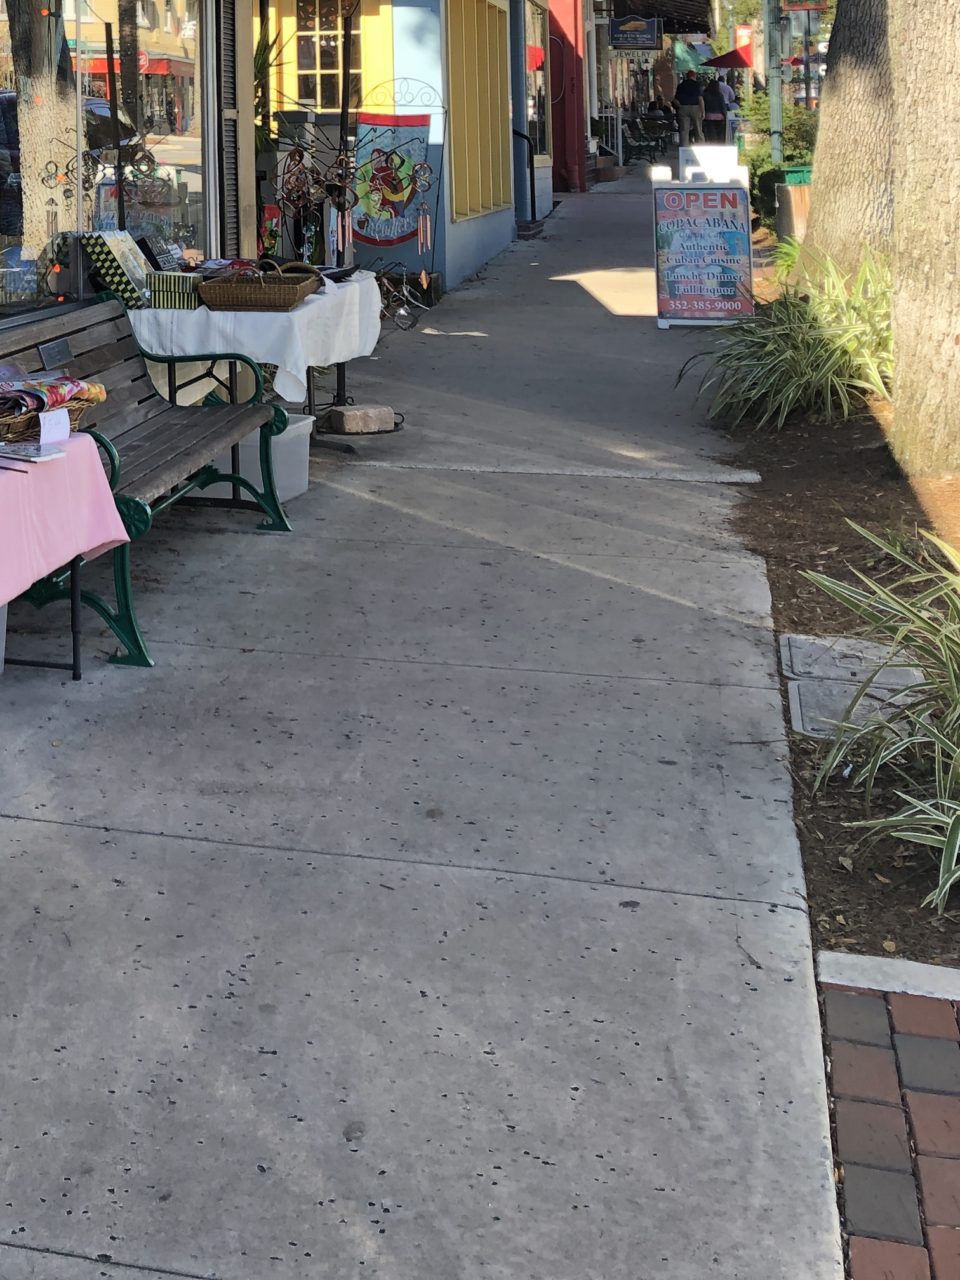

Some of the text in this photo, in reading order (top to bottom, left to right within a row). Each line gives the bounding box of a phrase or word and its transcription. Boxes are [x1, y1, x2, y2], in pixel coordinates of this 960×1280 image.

[664, 192, 739, 210] OPEN
[658, 217, 746, 233] COPACABANA
[680, 242, 728, 251] Authentic
[666, 256, 742, 265] Cuban Cuisine
[666, 271, 698, 280] Lunch
[707, 271, 743, 281] Dinner
[676, 284, 734, 297] Full Liquor
[669, 300, 741, 310] 352-385-9000
